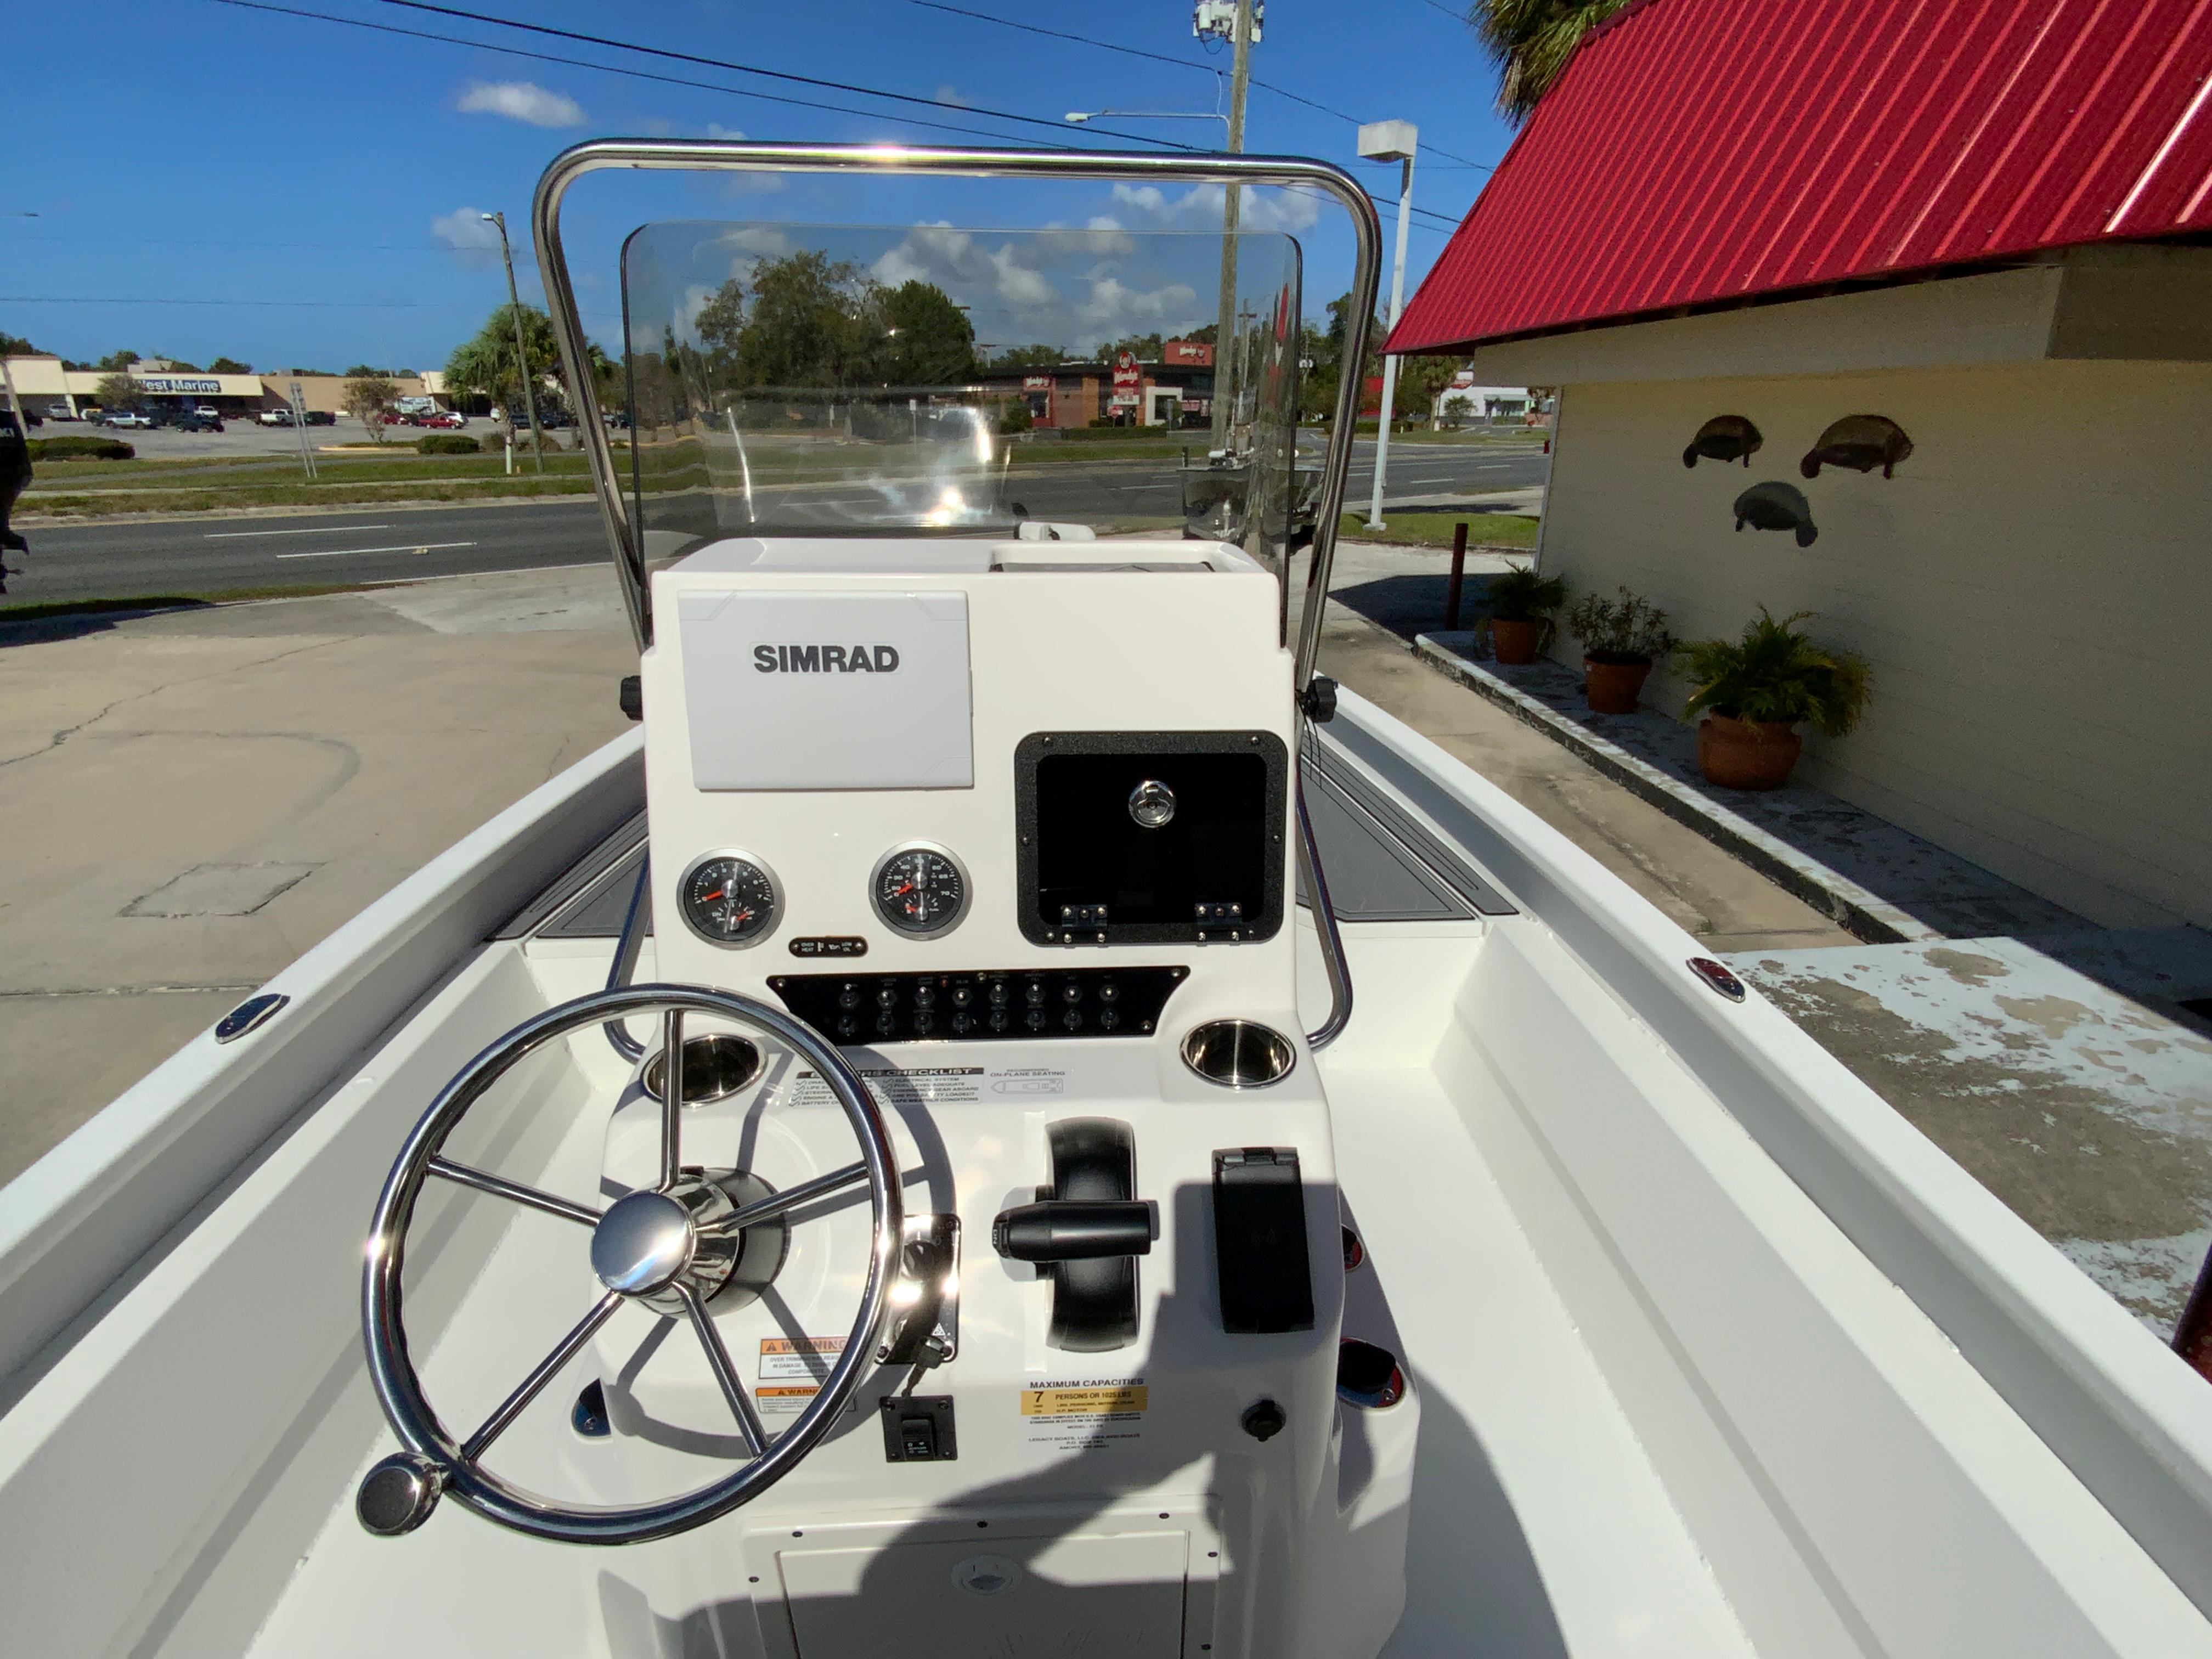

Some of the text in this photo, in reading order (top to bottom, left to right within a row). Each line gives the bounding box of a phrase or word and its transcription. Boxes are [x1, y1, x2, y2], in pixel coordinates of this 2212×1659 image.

[171, 380, 218, 391] Marine
[754, 645, 899, 673] SIMRAD
[1030, 1378, 1144, 1389] MAXIMUM CAPACITIES
[1034, 1391, 1044, 1403] 7
